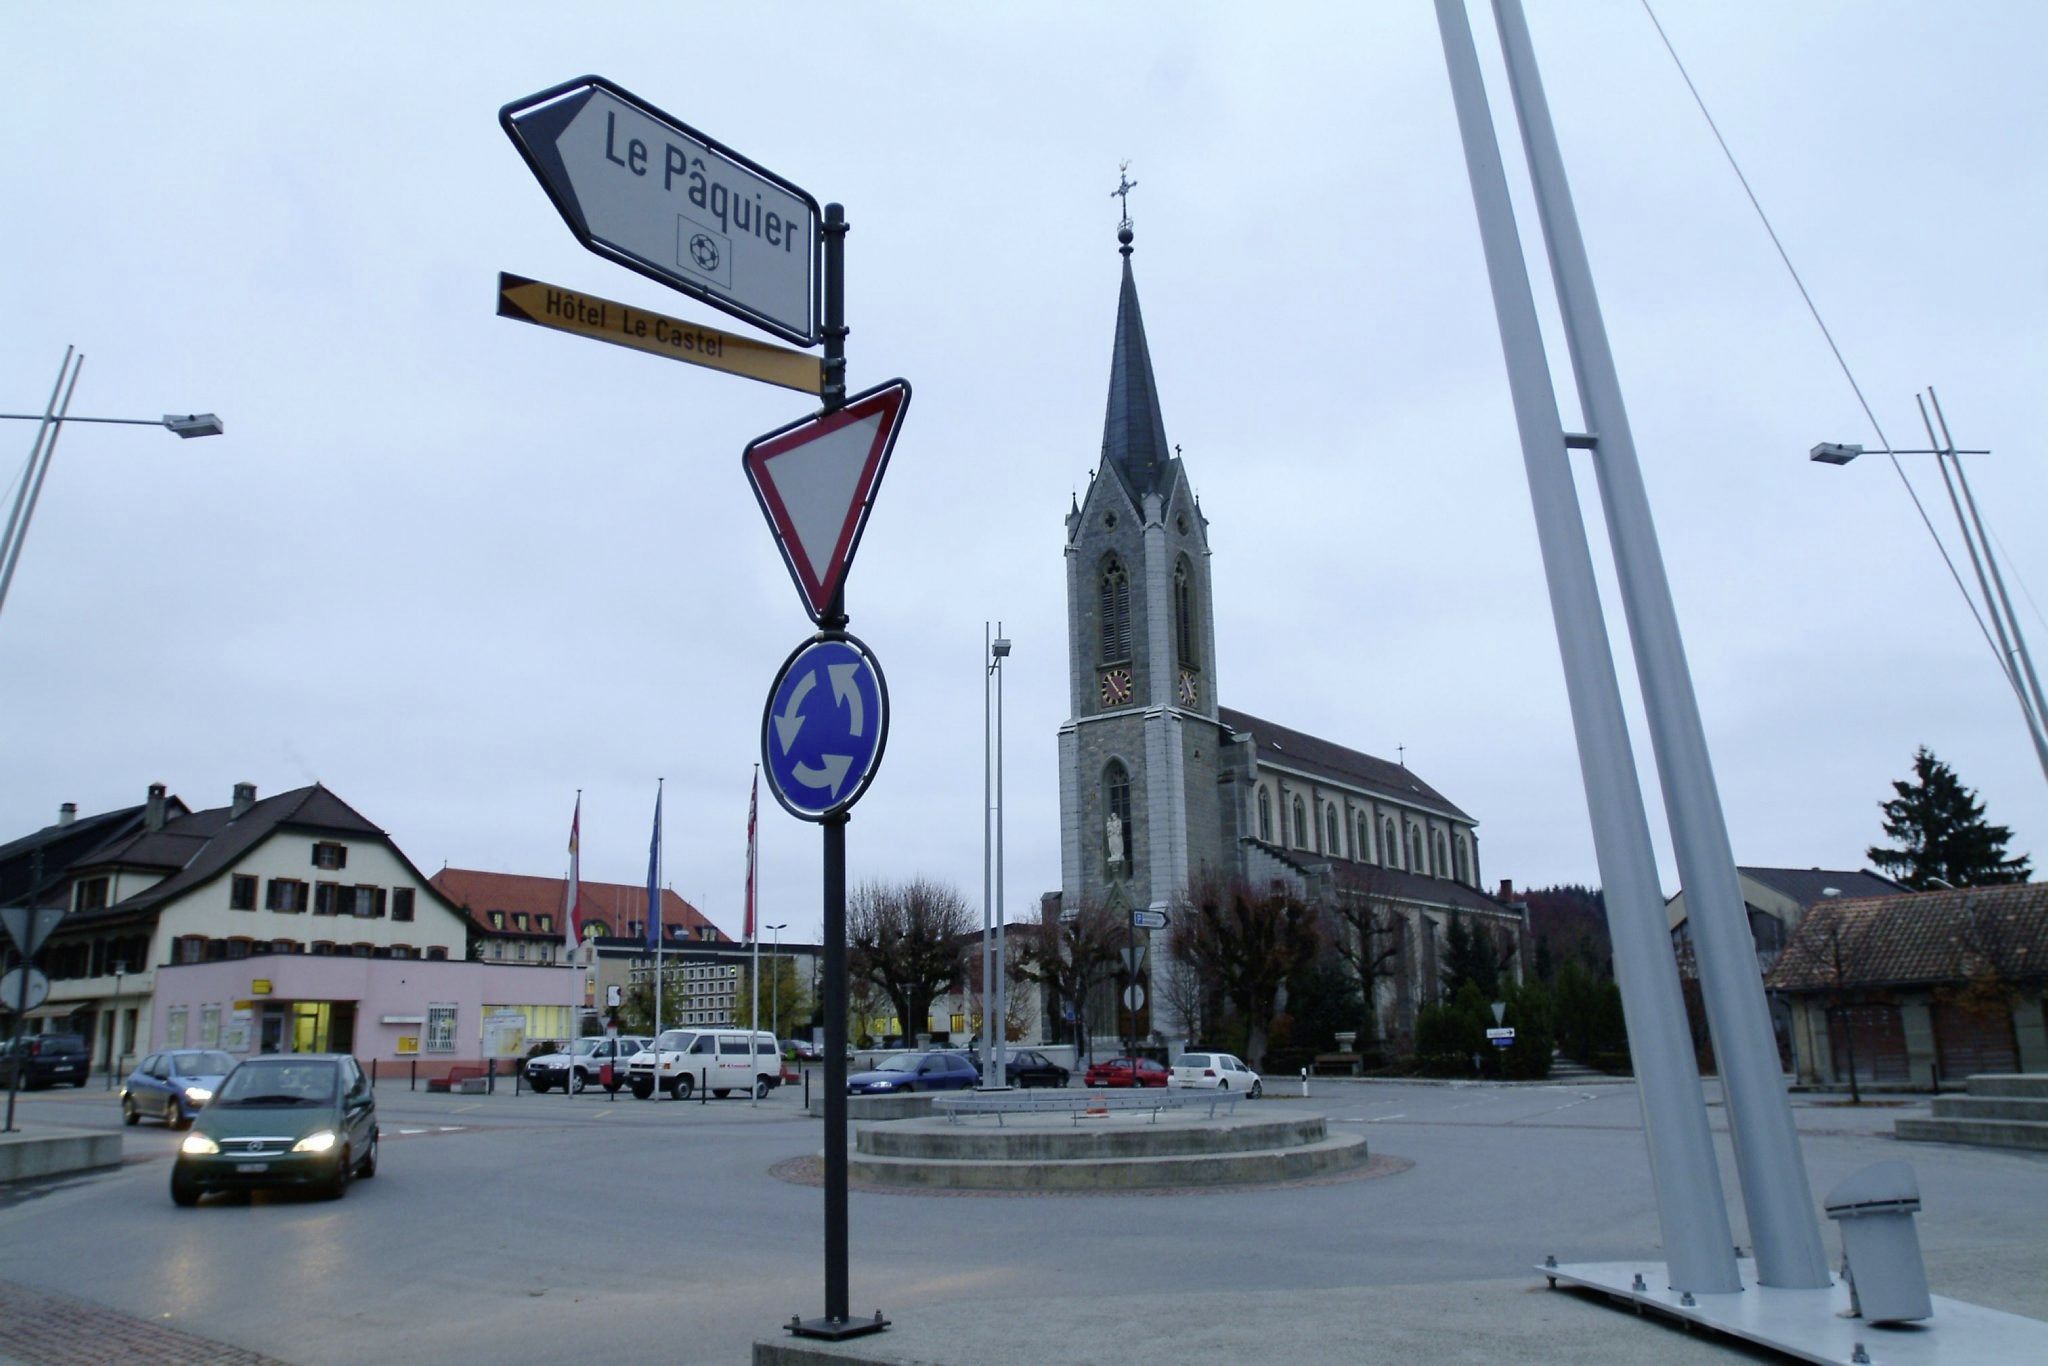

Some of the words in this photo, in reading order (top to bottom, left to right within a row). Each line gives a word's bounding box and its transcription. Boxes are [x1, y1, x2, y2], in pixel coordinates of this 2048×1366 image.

[605, 111, 648, 177] Le
[664, 142, 798, 252] Pâquier
[546, 289, 607, 328] Hôtel
[622, 310, 647, 338] Le
[655, 321, 723, 358] Castel
